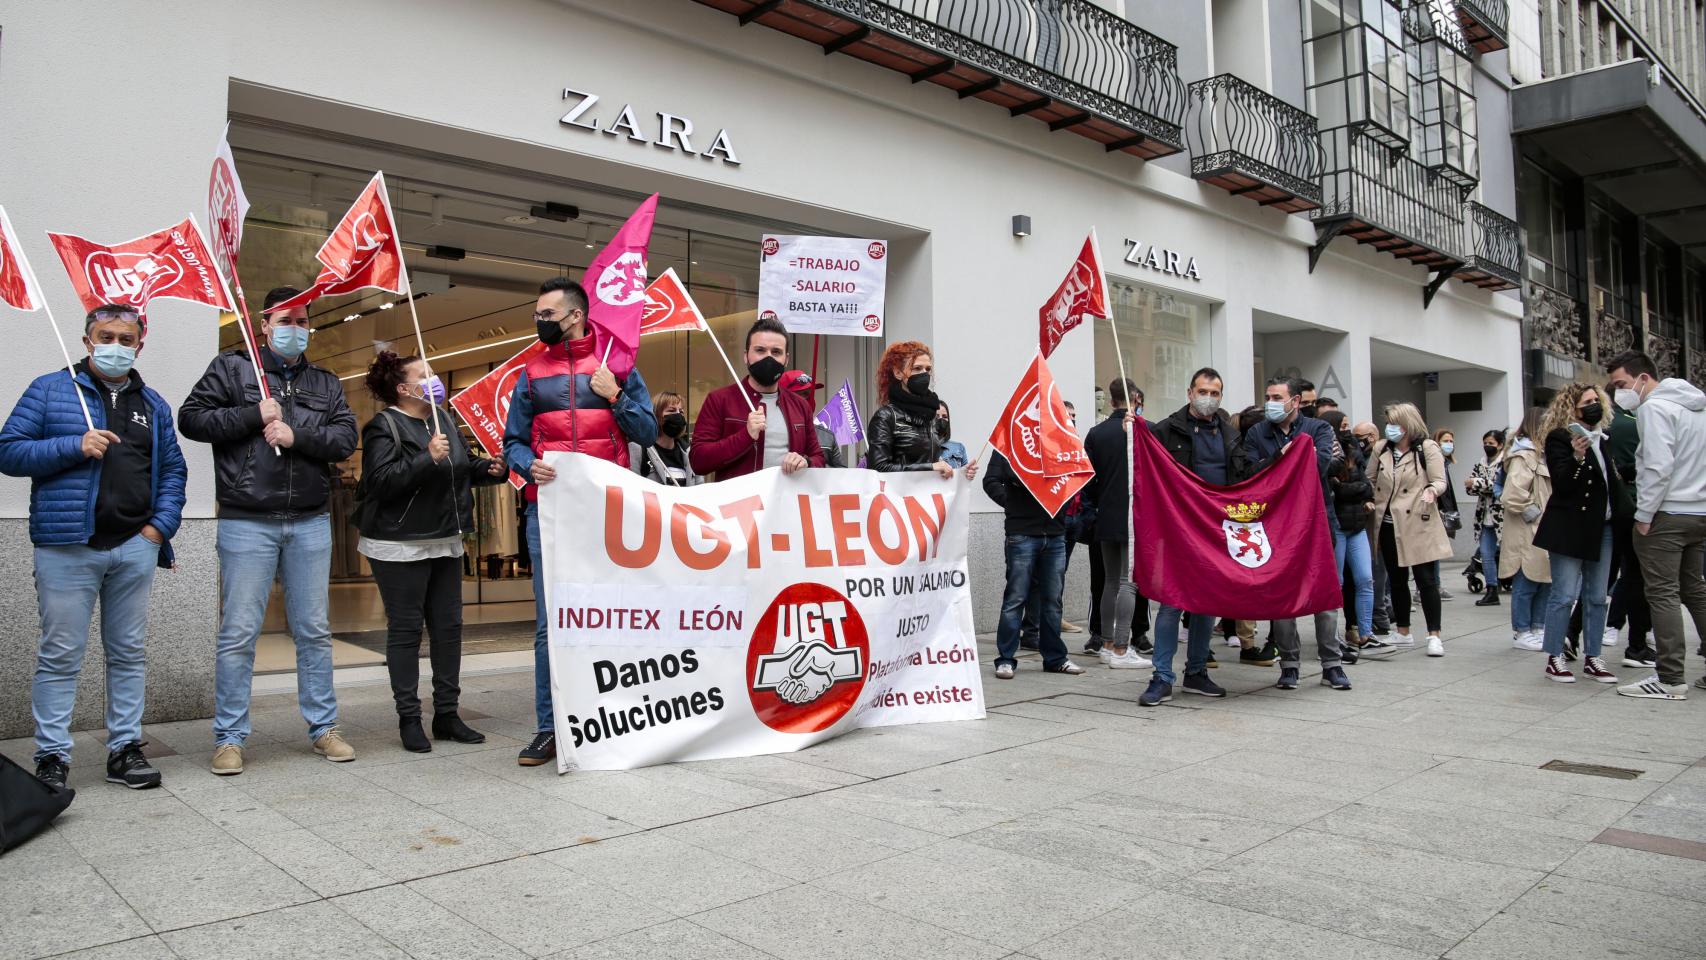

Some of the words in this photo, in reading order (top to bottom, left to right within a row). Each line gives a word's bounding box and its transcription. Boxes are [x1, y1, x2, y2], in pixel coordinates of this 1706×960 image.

[559, 88, 741, 165] ZARA
[789, 257, 860, 272] =TRABAJO
[1124, 238, 1200, 281] ZARA
[792, 279, 856, 293] -SALARIO
[789, 301, 826, 313] BASTA
[830, 303, 858, 314] YA!!!
[604, 480, 946, 570] UGT-LEÓN
[846, 577, 885, 598] POR
[893, 575, 914, 595] UN
[558, 607, 660, 630] INDITEX
[679, 605, 743, 631] LEÓN
[773, 601, 847, 654] UGT
[896, 613, 930, 638] JUSTO
[592, 648, 699, 694] Danos
[868, 651, 922, 682] Plataforma
[926, 644, 975, 665] León
[913, 685, 972, 705] existe
